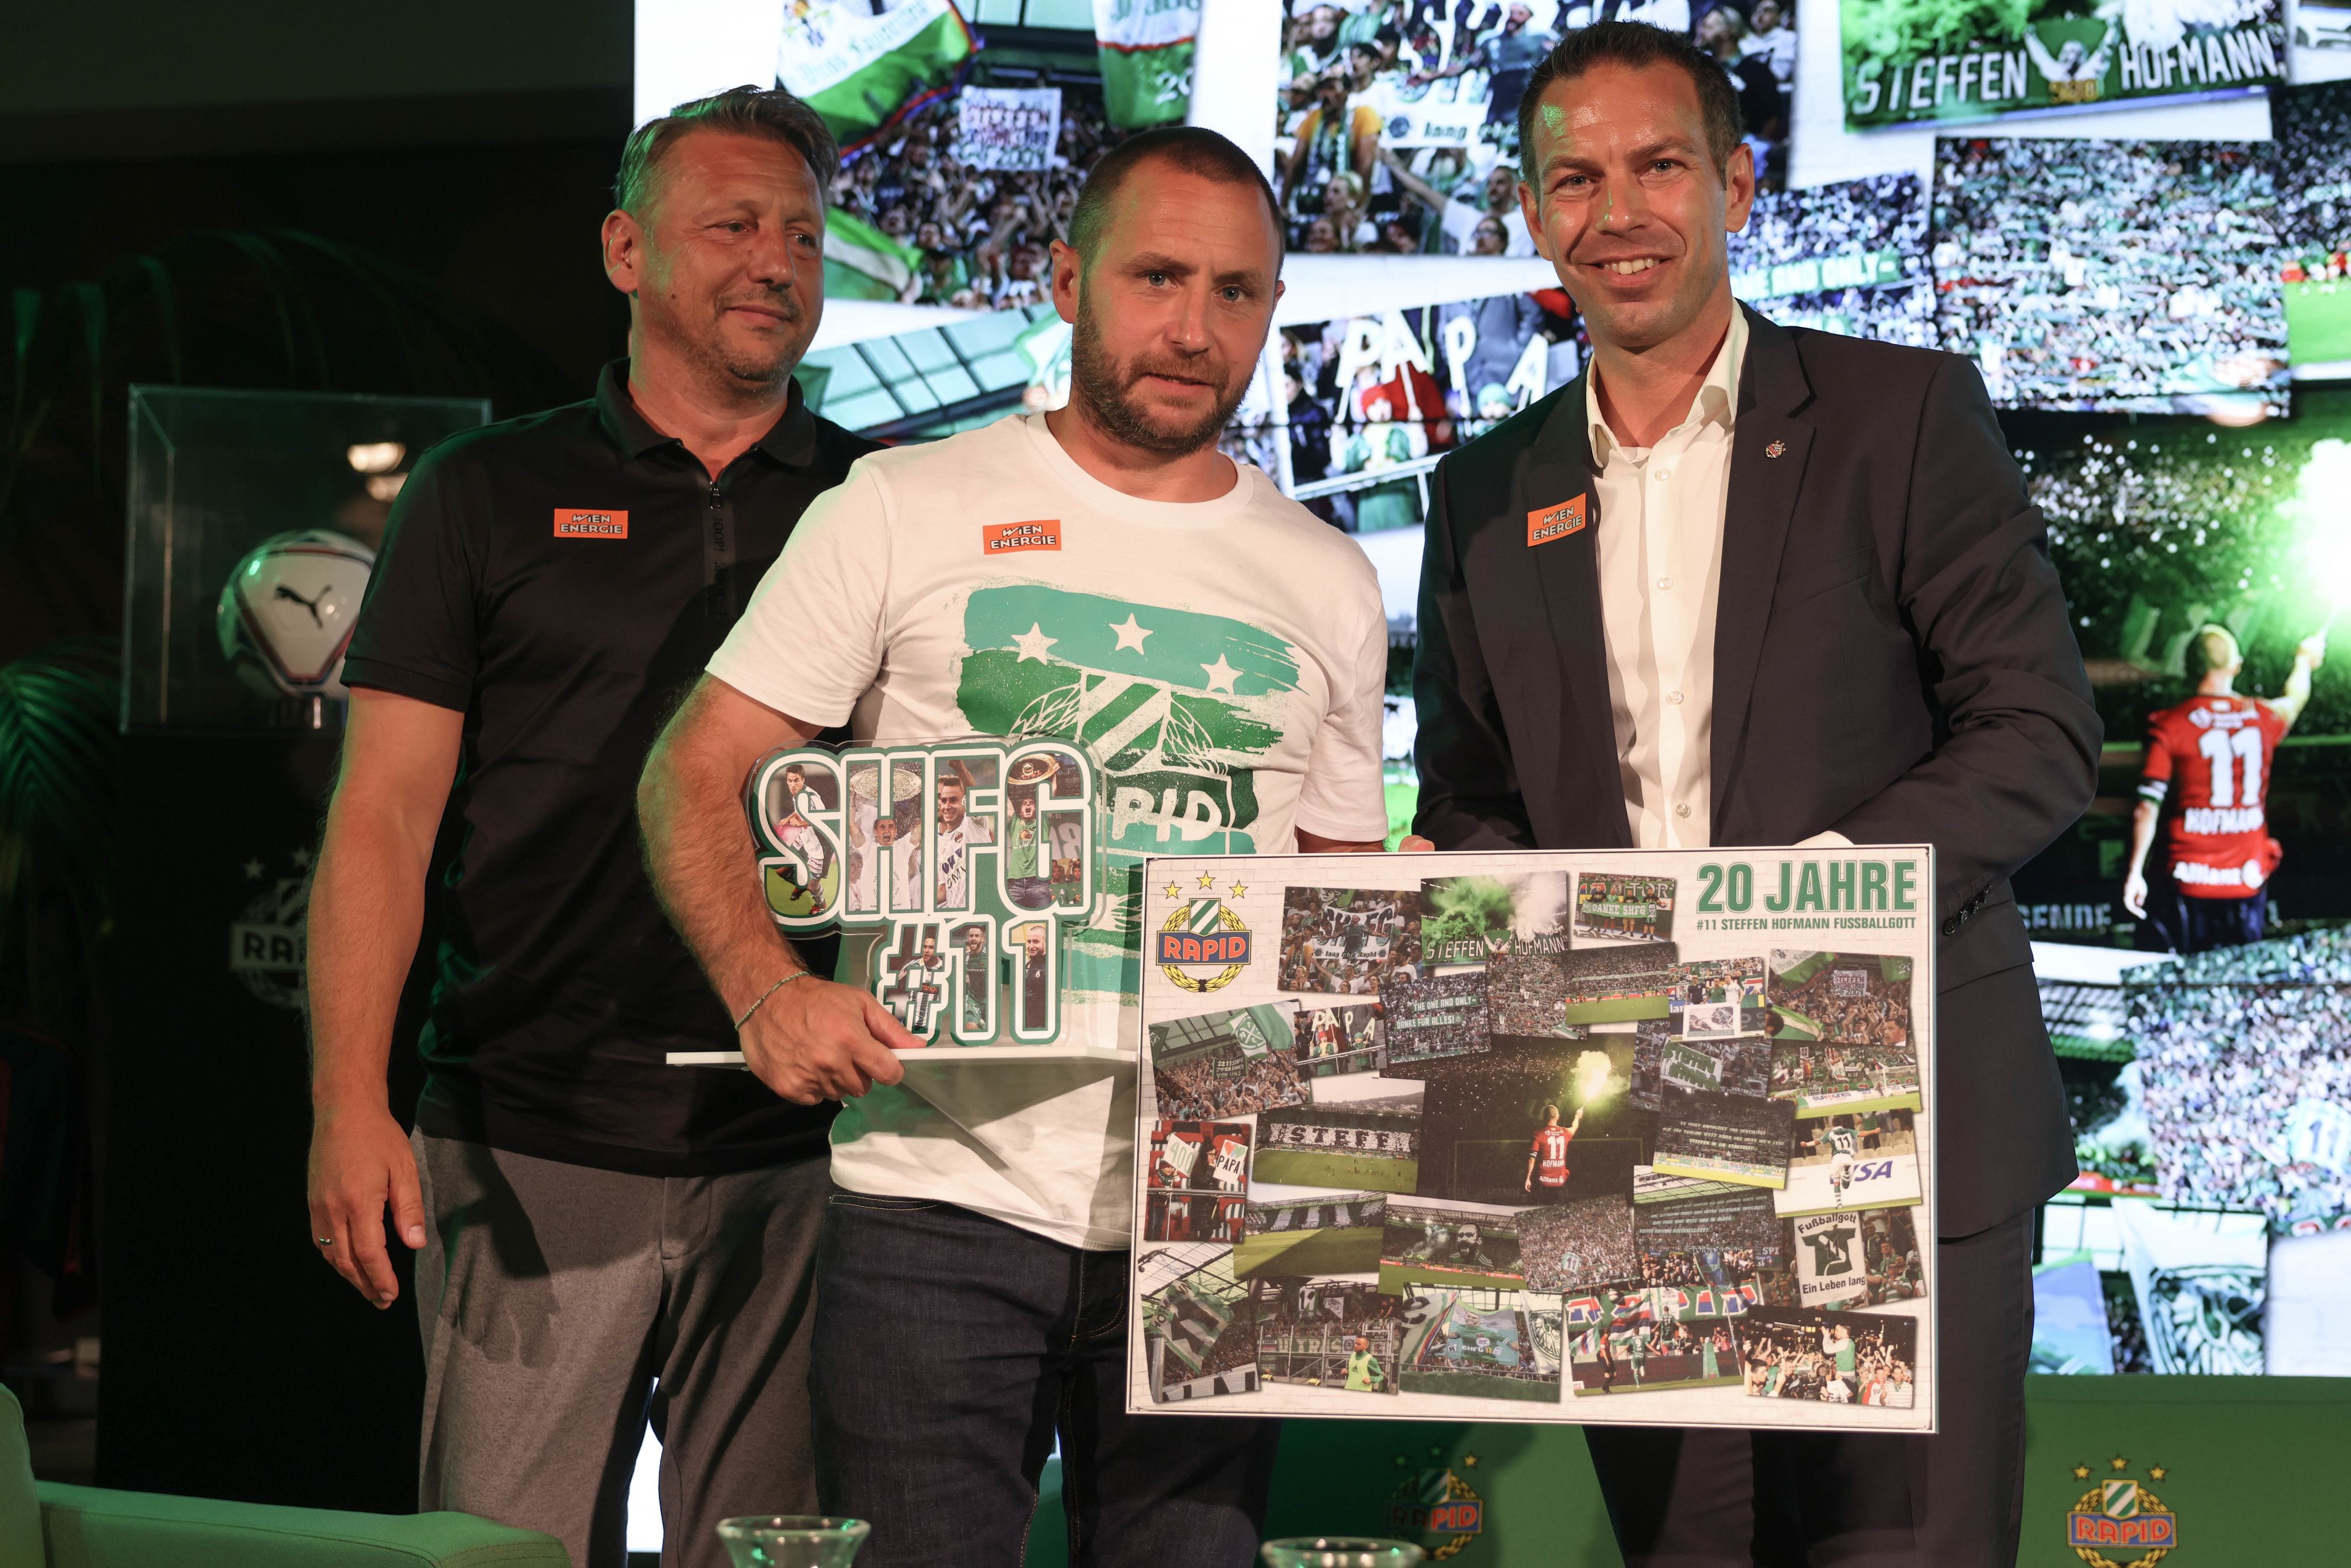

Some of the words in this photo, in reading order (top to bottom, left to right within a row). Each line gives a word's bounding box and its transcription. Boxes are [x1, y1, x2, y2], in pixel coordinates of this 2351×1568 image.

[1853, 49, 2028, 115] STEFFEN
[2118, 28, 2279, 92] HOFMANN
[572, 514, 611, 523] WIEN
[1543, 505, 1574, 526] WIEN
[561, 524, 622, 534] ENERGIE
[1002, 525, 1043, 537] WIEN
[1533, 515, 1582, 541] ENERGIE
[990, 535, 1056, 549] ENERGIE
[2198, 726, 2263, 807] 11
[1095, 786, 1223, 842] PID
[757, 742, 1092, 924] SHFG
[1696, 862, 1754, 913] 20
[1763, 860, 1917, 913] JAHRE
[1592, 903, 1620, 915] DANKE
[1623, 904, 1646, 915] SHFG
[1696, 919, 1717, 930] #11
[1722, 918, 1768, 930] STEFFEN
[1772, 917, 1830, 929] HOFMANN
[1834, 917, 1916, 929] FUSSBALLGOTT
[1164, 936, 1247, 961] RAPID
[1426, 940, 1484, 960] STEFFEN
[878, 914, 1056, 1040] #11
[1414, 1003, 1426, 1011] THE
[1427, 1001, 1440, 1010] ONE
[1441, 999, 1454, 1007] AND
[1396, 1020, 1416, 1029] DANKE
[1431, 1015, 1455, 1026] ALLES!
[1547, 1135, 1565, 1160] 11
[1837, 1136, 1850, 1149] 11
[1170, 1141, 1195, 1174] 400
[1217, 1155, 1241, 1174] PAPA
[1797, 1212, 1857, 1234] Fußballgott
[1825, 1236, 1840, 1260] 11
[1567, 1257, 1577, 1270] 11
[1802, 1283, 1817, 1294] Ein
[1820, 1280, 1846, 1291] Leben
[1848, 1276, 1866, 1286] lang
[1635, 1337, 1641, 1347] 9
[1392, 1505, 1478, 1530] RAPID
[2075, 1516, 2172, 1544] RAPID
